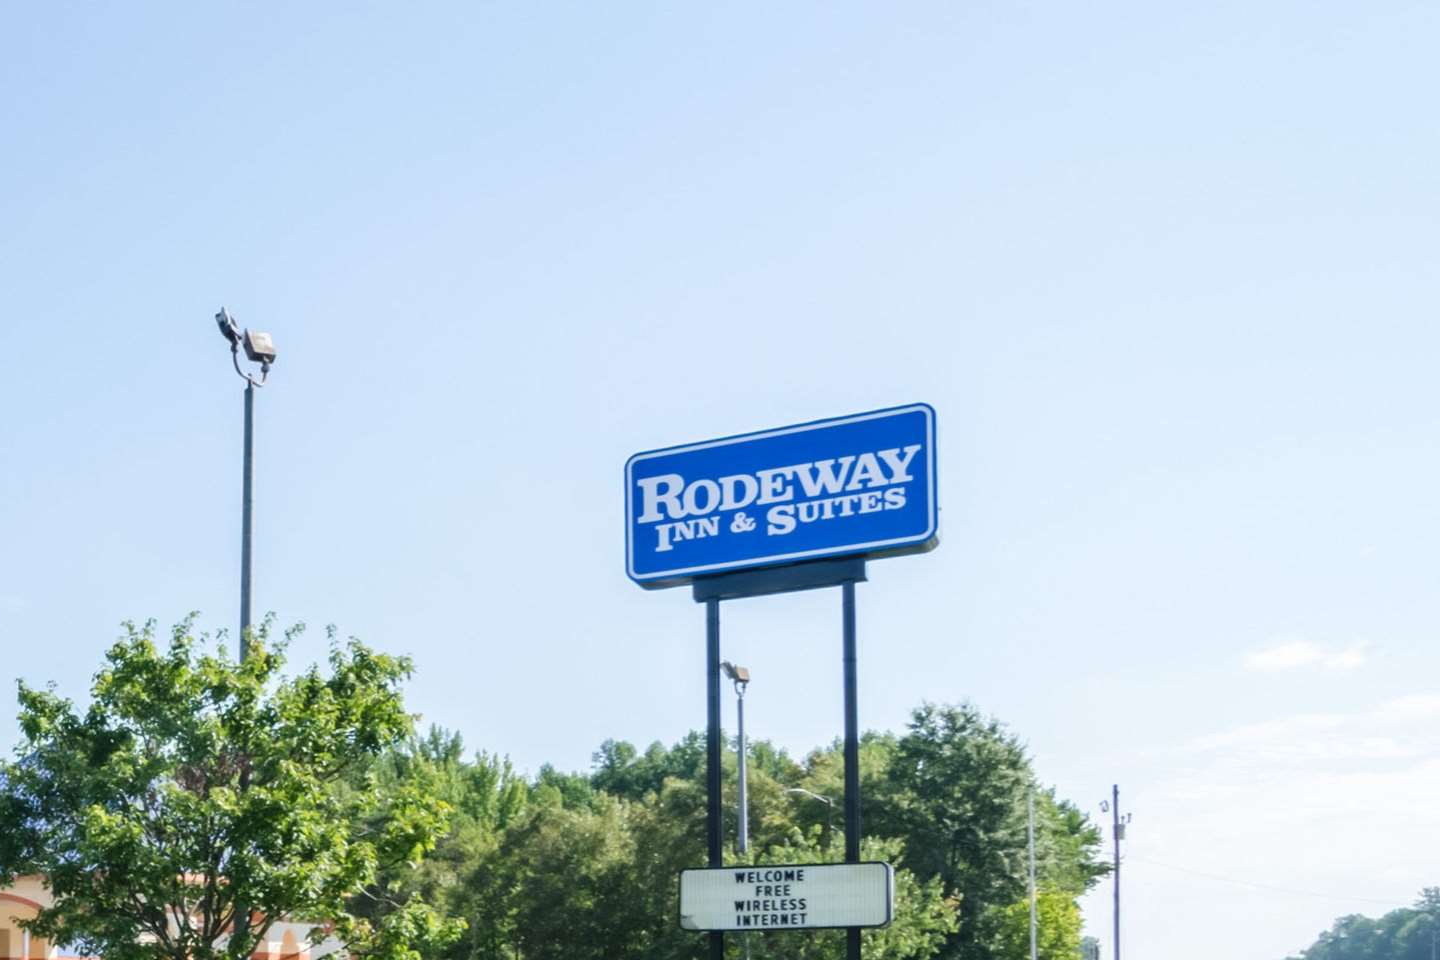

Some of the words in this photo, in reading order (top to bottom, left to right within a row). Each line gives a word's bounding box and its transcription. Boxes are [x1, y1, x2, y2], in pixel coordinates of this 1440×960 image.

[637, 444, 922, 525] RODEWAY
[654, 516, 721, 553] INN
[730, 511, 757, 534] &
[766, 487, 907, 536] SUITES
[734, 869, 804, 883] WELCOME
[755, 884, 792, 898] FREE
[734, 898, 807, 912] WIRELESS
[736, 913, 808, 927] INTERNET
